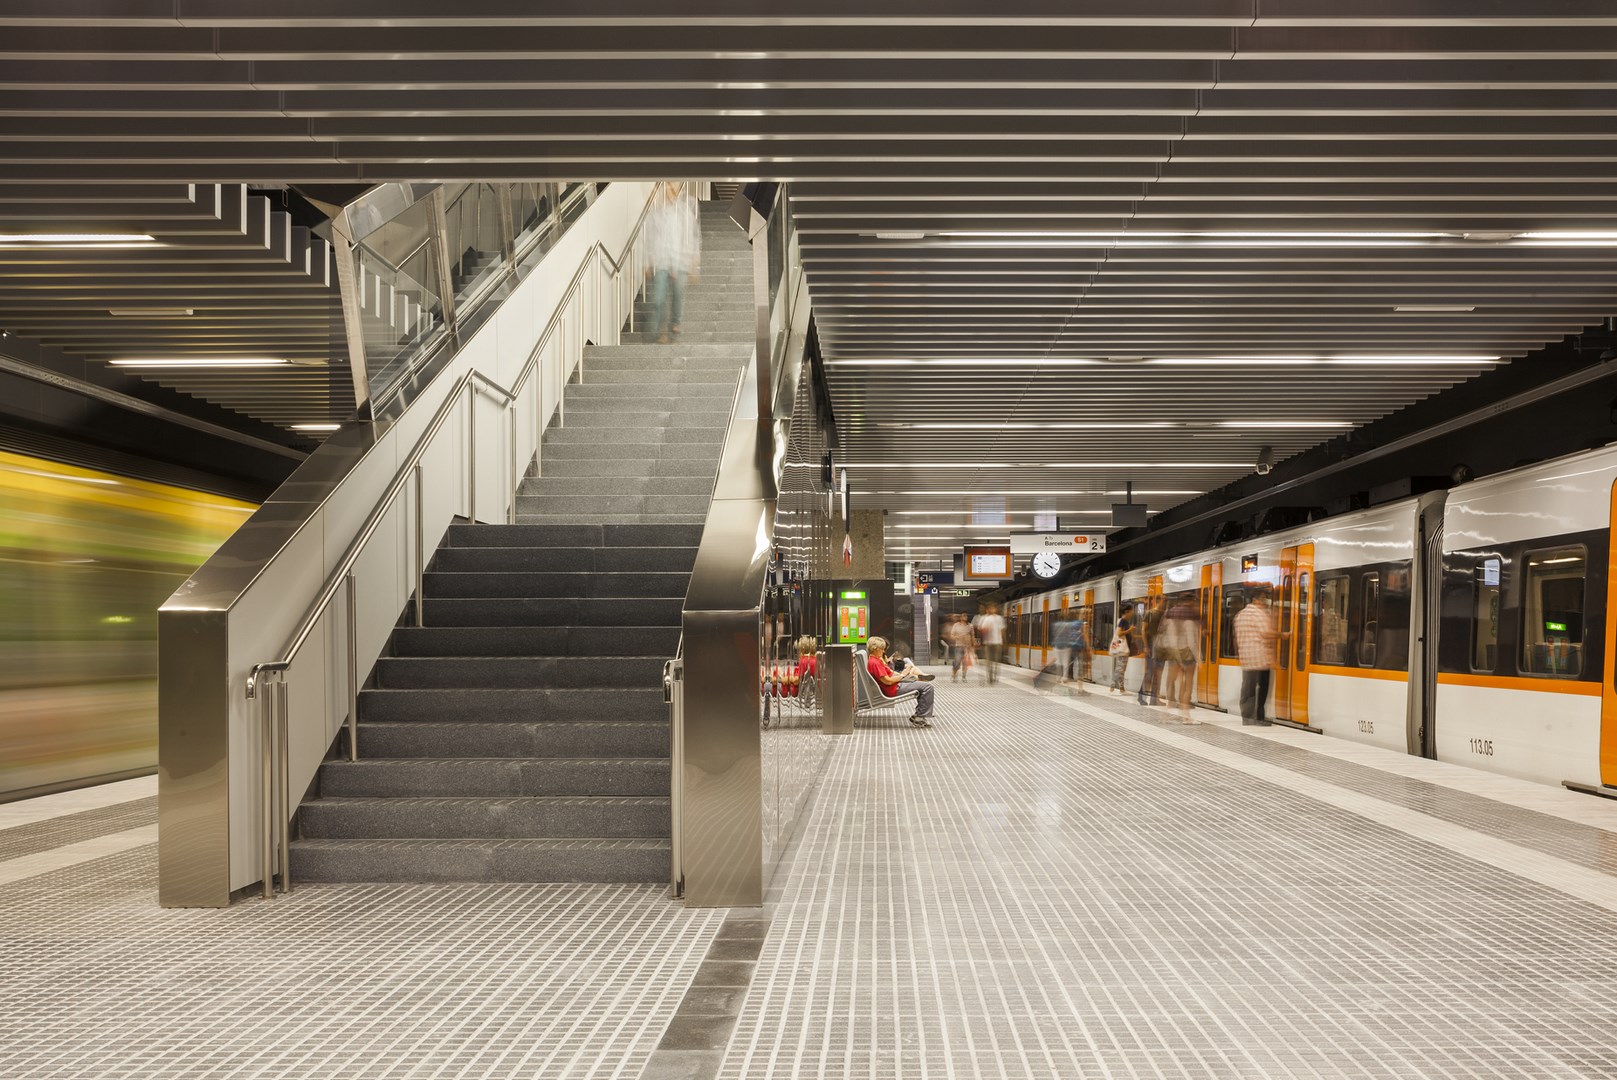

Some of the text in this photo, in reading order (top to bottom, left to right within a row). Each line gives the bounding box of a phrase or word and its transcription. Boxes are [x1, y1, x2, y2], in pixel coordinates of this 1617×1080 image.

[1091, 541, 1098, 550] 2
[1358, 719, 1374, 734] 123.05
[1470, 738, 1494, 756] 113.05
